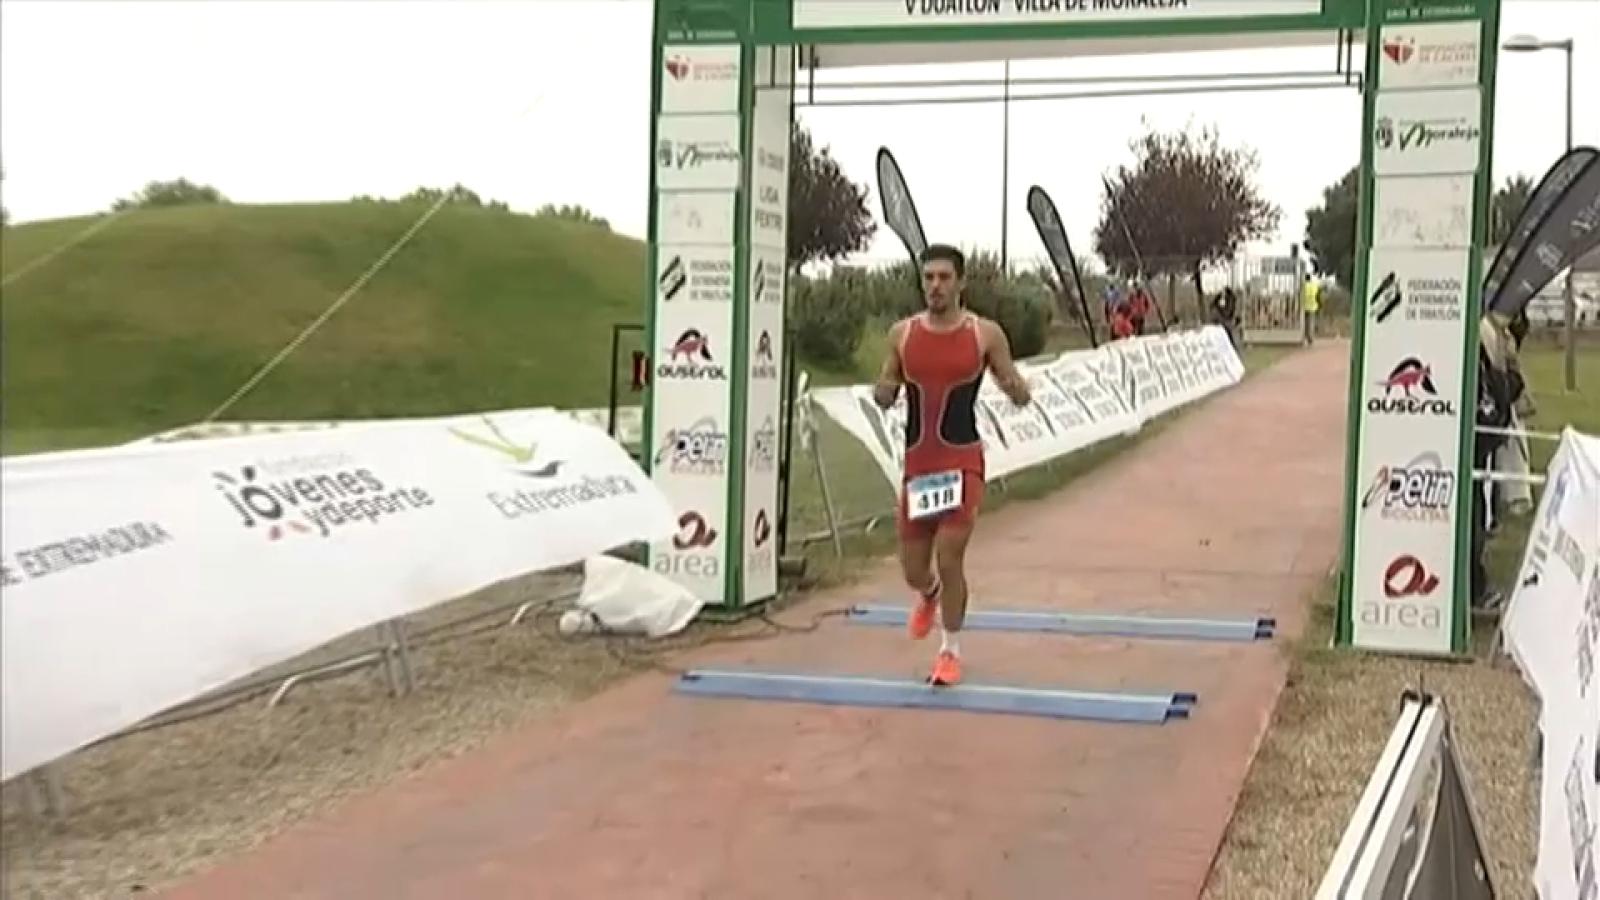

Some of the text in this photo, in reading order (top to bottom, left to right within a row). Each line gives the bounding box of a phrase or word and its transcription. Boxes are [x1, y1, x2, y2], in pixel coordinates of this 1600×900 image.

[1367, 398, 1456, 416] austral
[486, 475, 637, 519] Extremadura
[15, 521, 174, 579] EXTREMADURA
[655, 551, 719, 577] area
[1361, 602, 1441, 629] area
